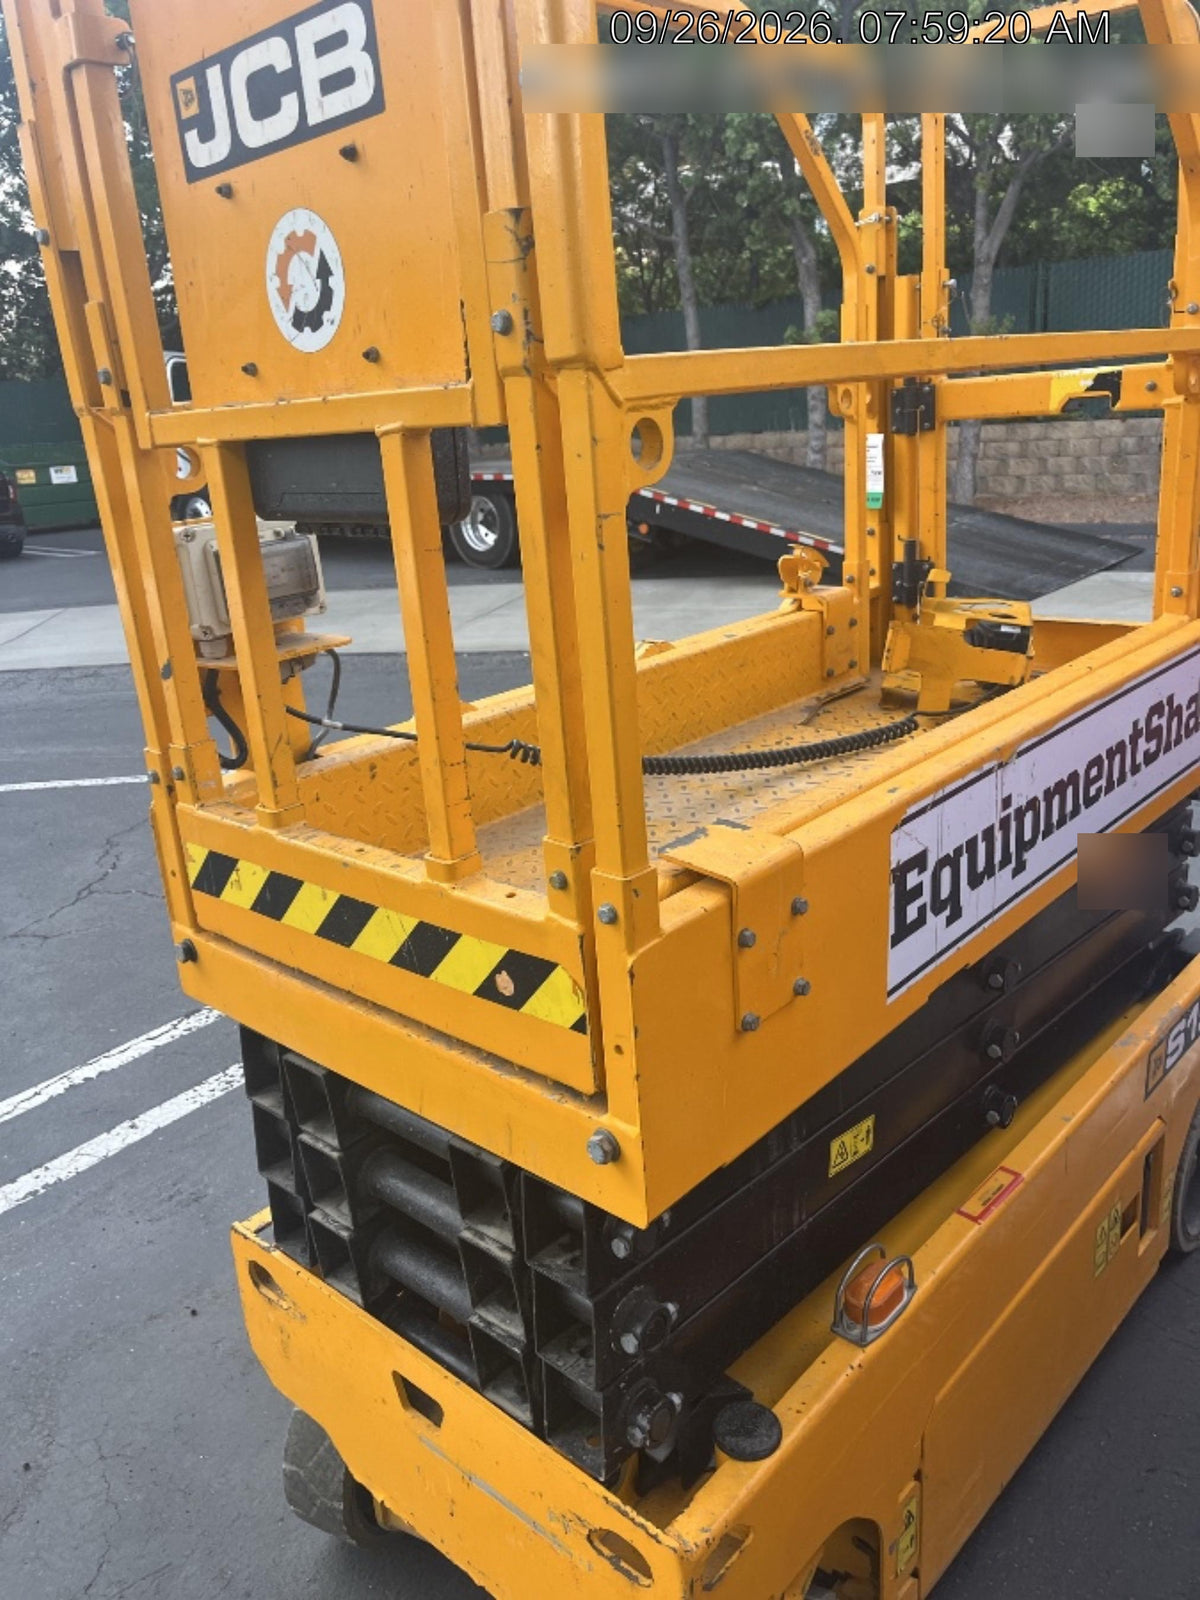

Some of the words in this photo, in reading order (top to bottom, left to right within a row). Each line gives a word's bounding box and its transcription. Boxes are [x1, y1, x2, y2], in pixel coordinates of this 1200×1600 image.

[184, 2, 376, 168] JCB
[890, 678, 1200, 950] EquipmentSha
[1165, 1001, 1200, 1070] S1
